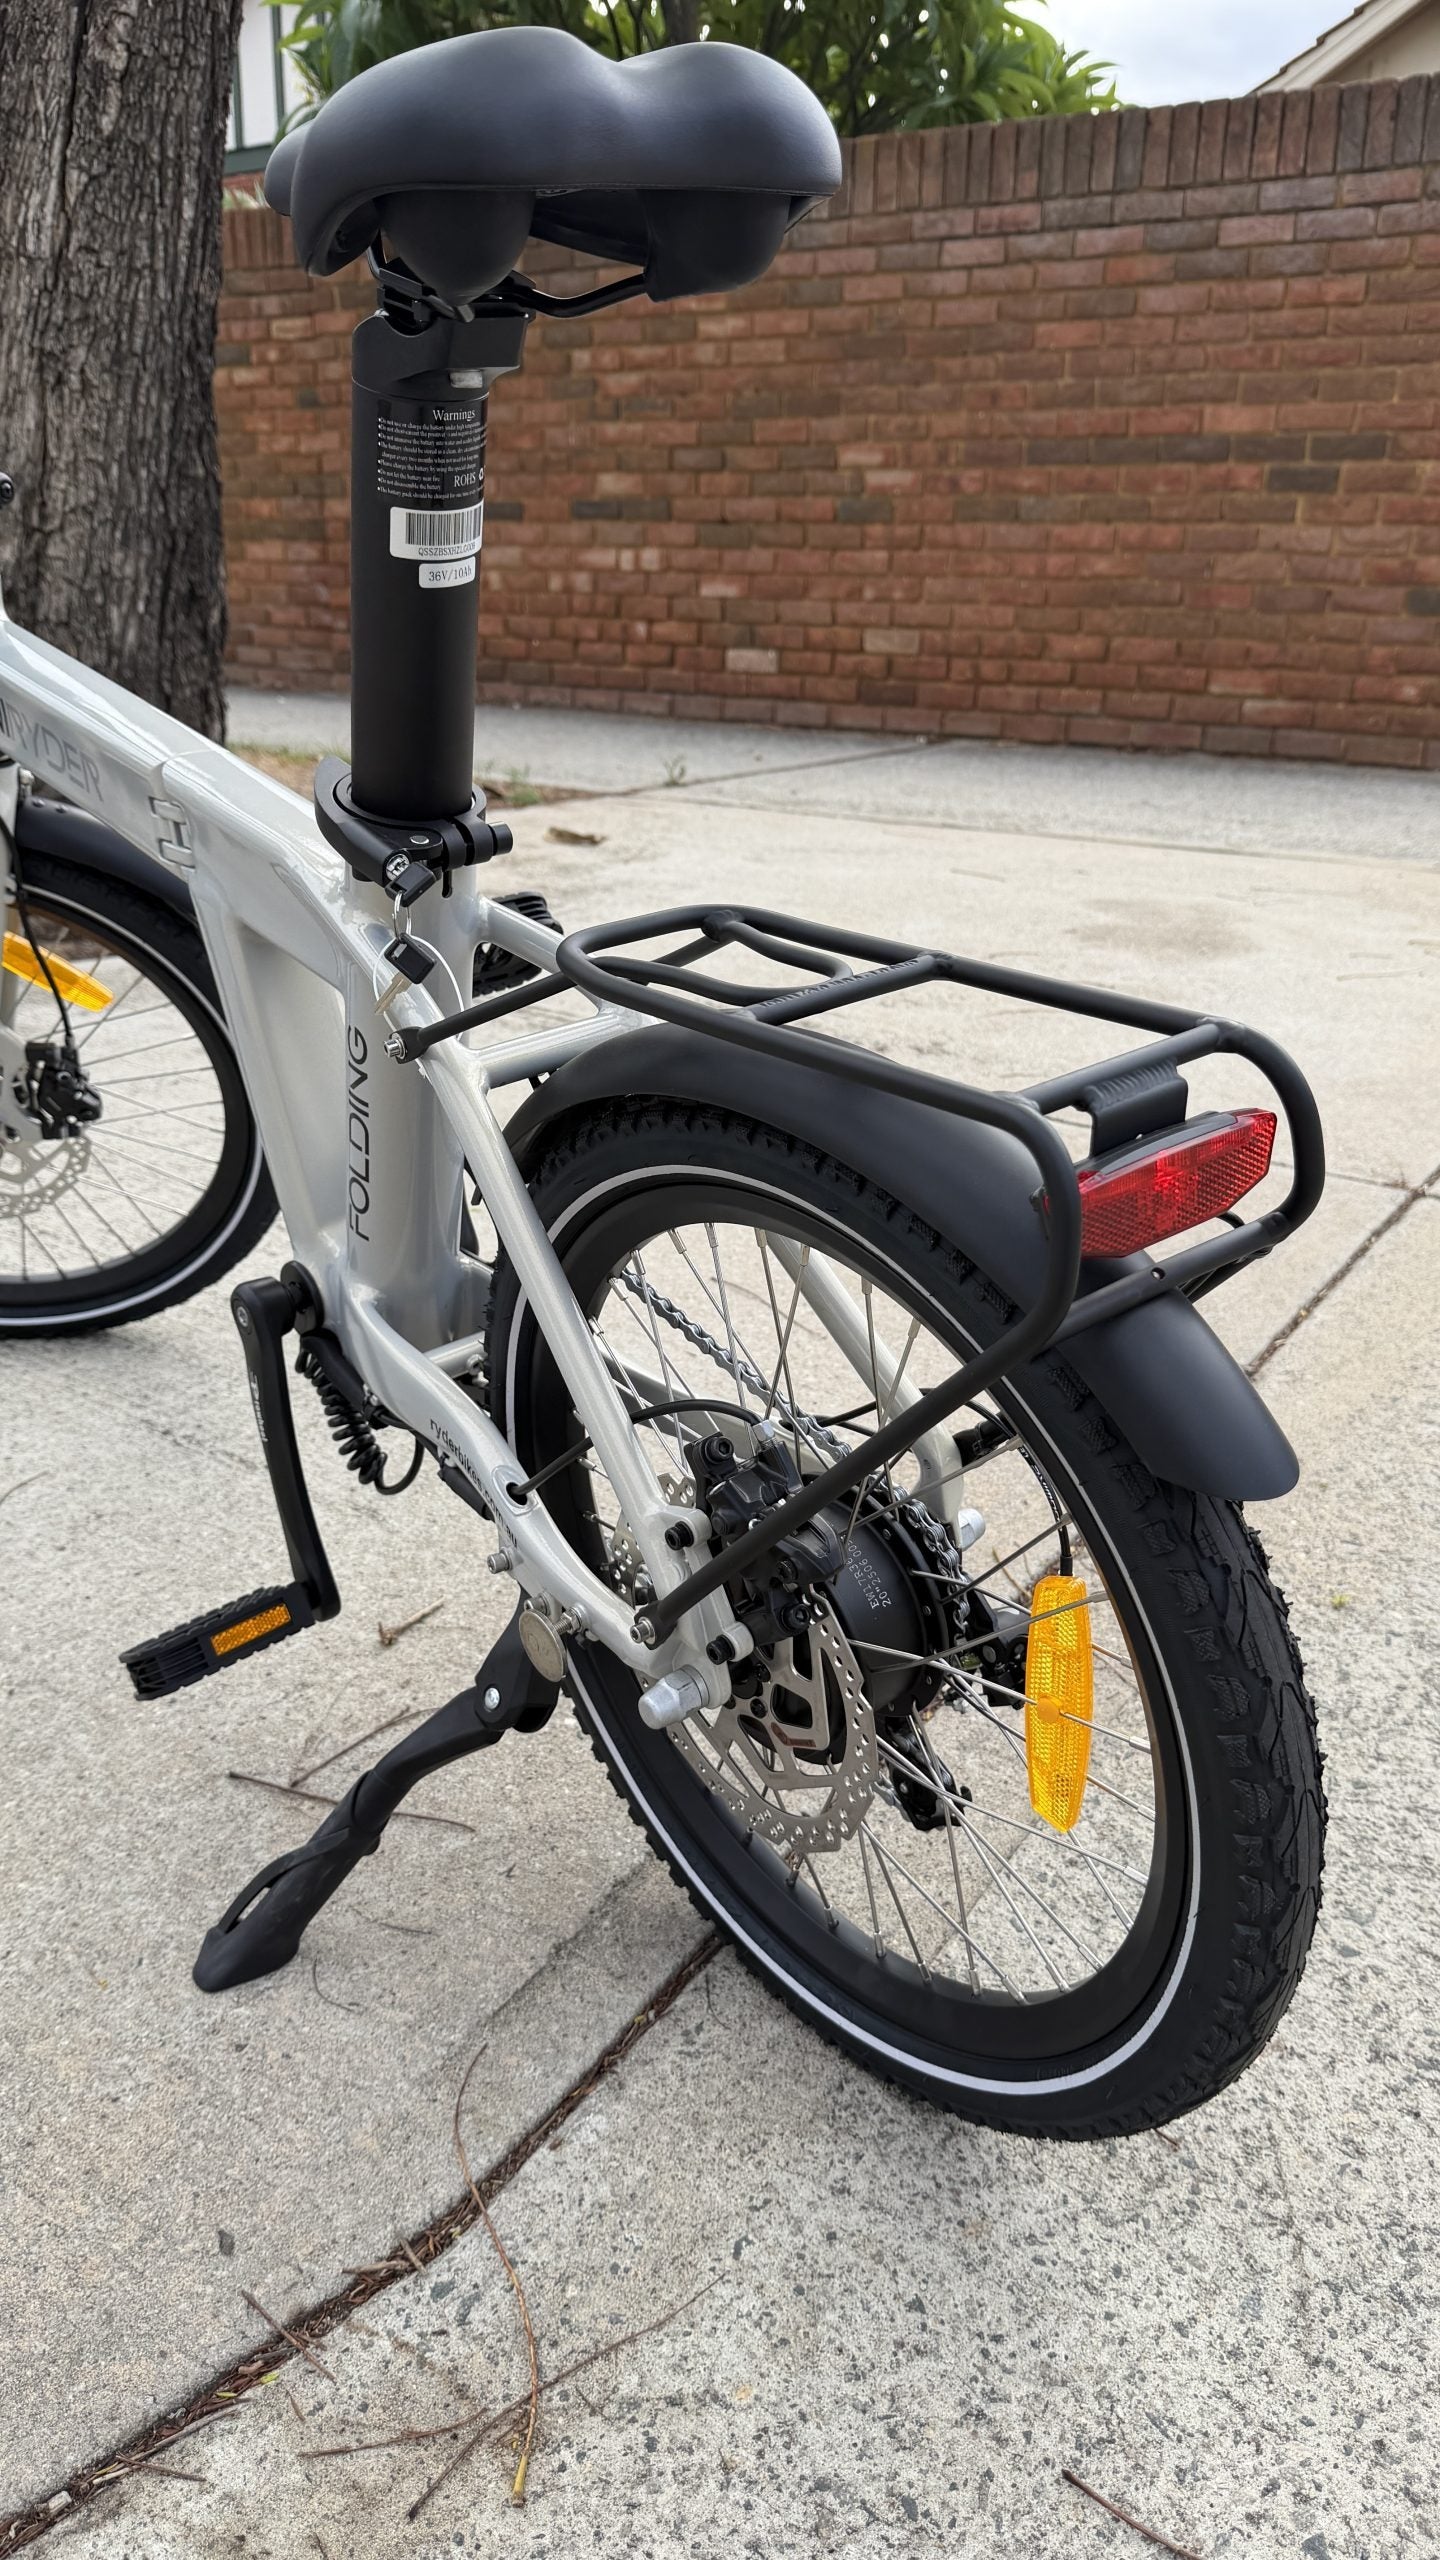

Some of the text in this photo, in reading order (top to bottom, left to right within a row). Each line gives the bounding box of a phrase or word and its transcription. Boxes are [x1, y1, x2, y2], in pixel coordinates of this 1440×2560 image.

[433, 409, 475, 422] Warnings
[454, 472, 476, 488] ROHS
[429, 565, 472, 582] 36V/10Ah
[348, 1025, 370, 1242] FOLDING
[430, 1418, 518, 1548] ryderbikes.com.au
